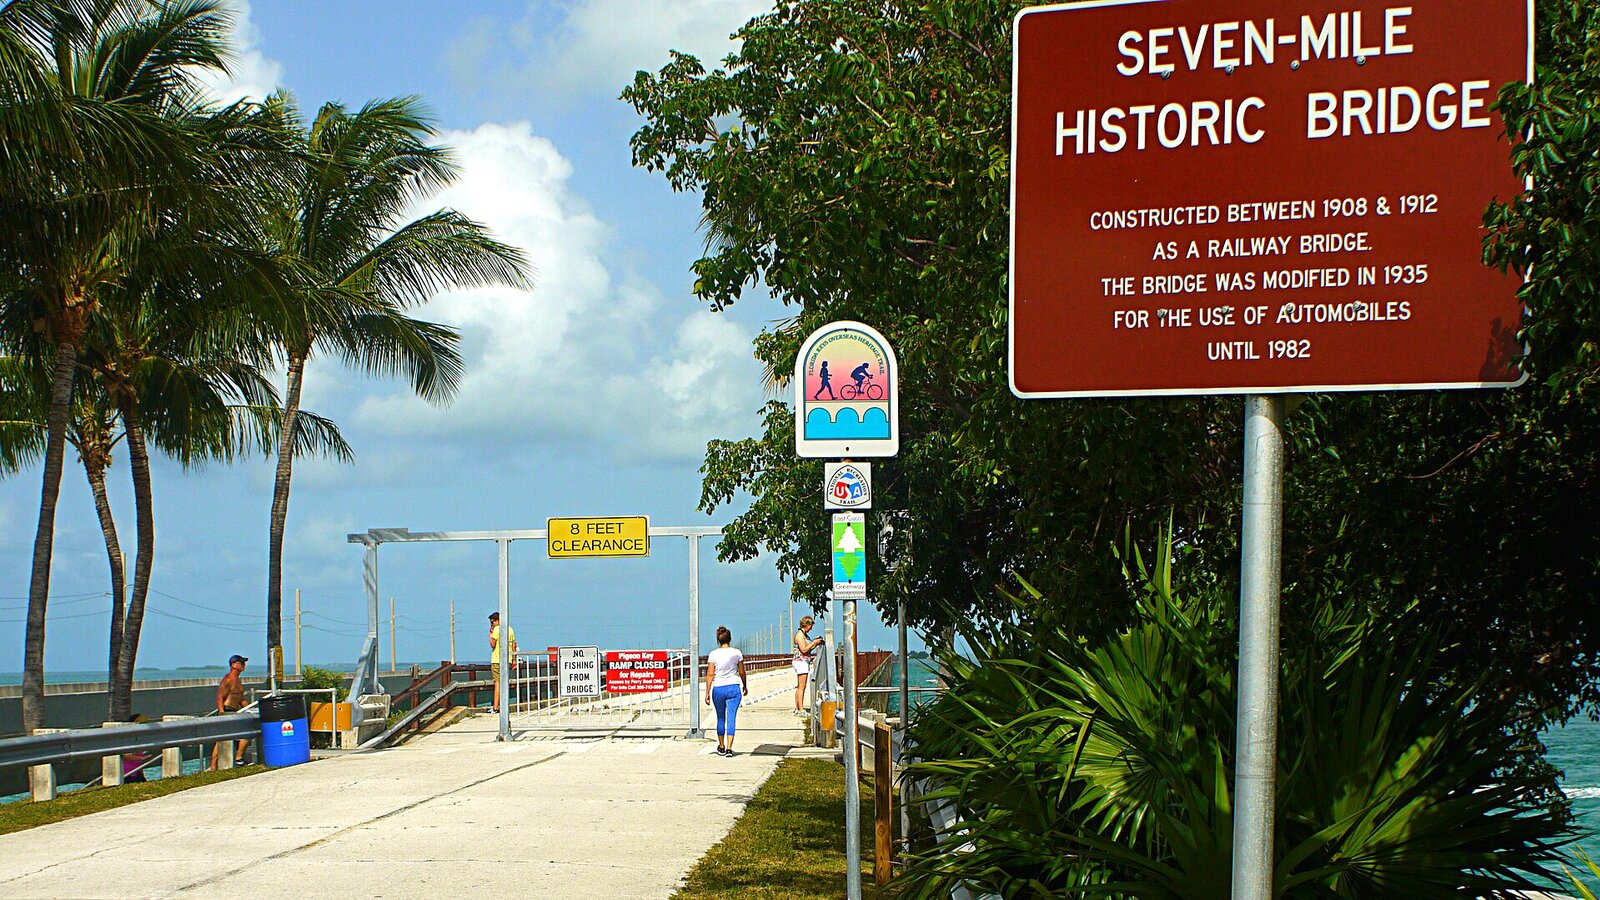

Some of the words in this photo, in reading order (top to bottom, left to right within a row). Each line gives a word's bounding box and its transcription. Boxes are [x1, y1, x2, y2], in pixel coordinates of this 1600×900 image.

[1116, 6, 1413, 77] SEVEN-MILE
[1055, 96, 1265, 156] HISTORIC
[1307, 79, 1491, 139] BRIDGE
[1090, 205, 1220, 230] CONSTRUCTED
[1227, 201, 1315, 223] BETWEEN
[1323, 197, 1368, 218] 1908
[1376, 196, 1391, 216] &
[1400, 194, 1438, 215] 1912
[1152, 241, 1178, 260] AS
[1186, 240, 1200, 259] A
[1208, 235, 1292, 258] RAILWAY
[1300, 232, 1373, 254] BRIDGE.
[1101, 276, 1135, 296] THE
[1142, 273, 1207, 295] BRIDGE
[1215, 271, 1256, 292] WAS
[1263, 268, 1350, 290] MODIFIED
[1357, 266, 1376, 286] IN
[1384, 264, 1428, 285] 1935
[1114, 309, 1149, 329] FOR
[1199, 306, 1235, 326] USE
[1244, 305, 1268, 325] OF
[1276, 301, 1411, 324] AUTOMOBILES
[808, 352, 818, 376] FLORIDA
[816, 341, 829, 353] KEYS
[828, 333, 857, 343] OVERSEAS
[857, 336, 881, 358] HERITAGE
[877, 357, 885, 376] TRAIL
[1207, 341, 1260, 361] UNTIL
[1267, 339, 1311, 359] 1982
[570, 523, 580, 535] 8
[586, 522, 624, 535] FEET
[551, 538, 644, 552] CLEARANCE
[573, 650, 584, 658] NO
[618, 652, 641, 660] Pigeon
[641, 652, 654, 660] Key
[564, 661, 594, 670] FISHING
[609, 661, 632, 670] RAMP
[634, 661, 665, 669] CLOSED
[569, 673, 590, 681] FROM
[630, 671, 655, 679] Repairs
[566, 684, 594, 694] BRIDGE
